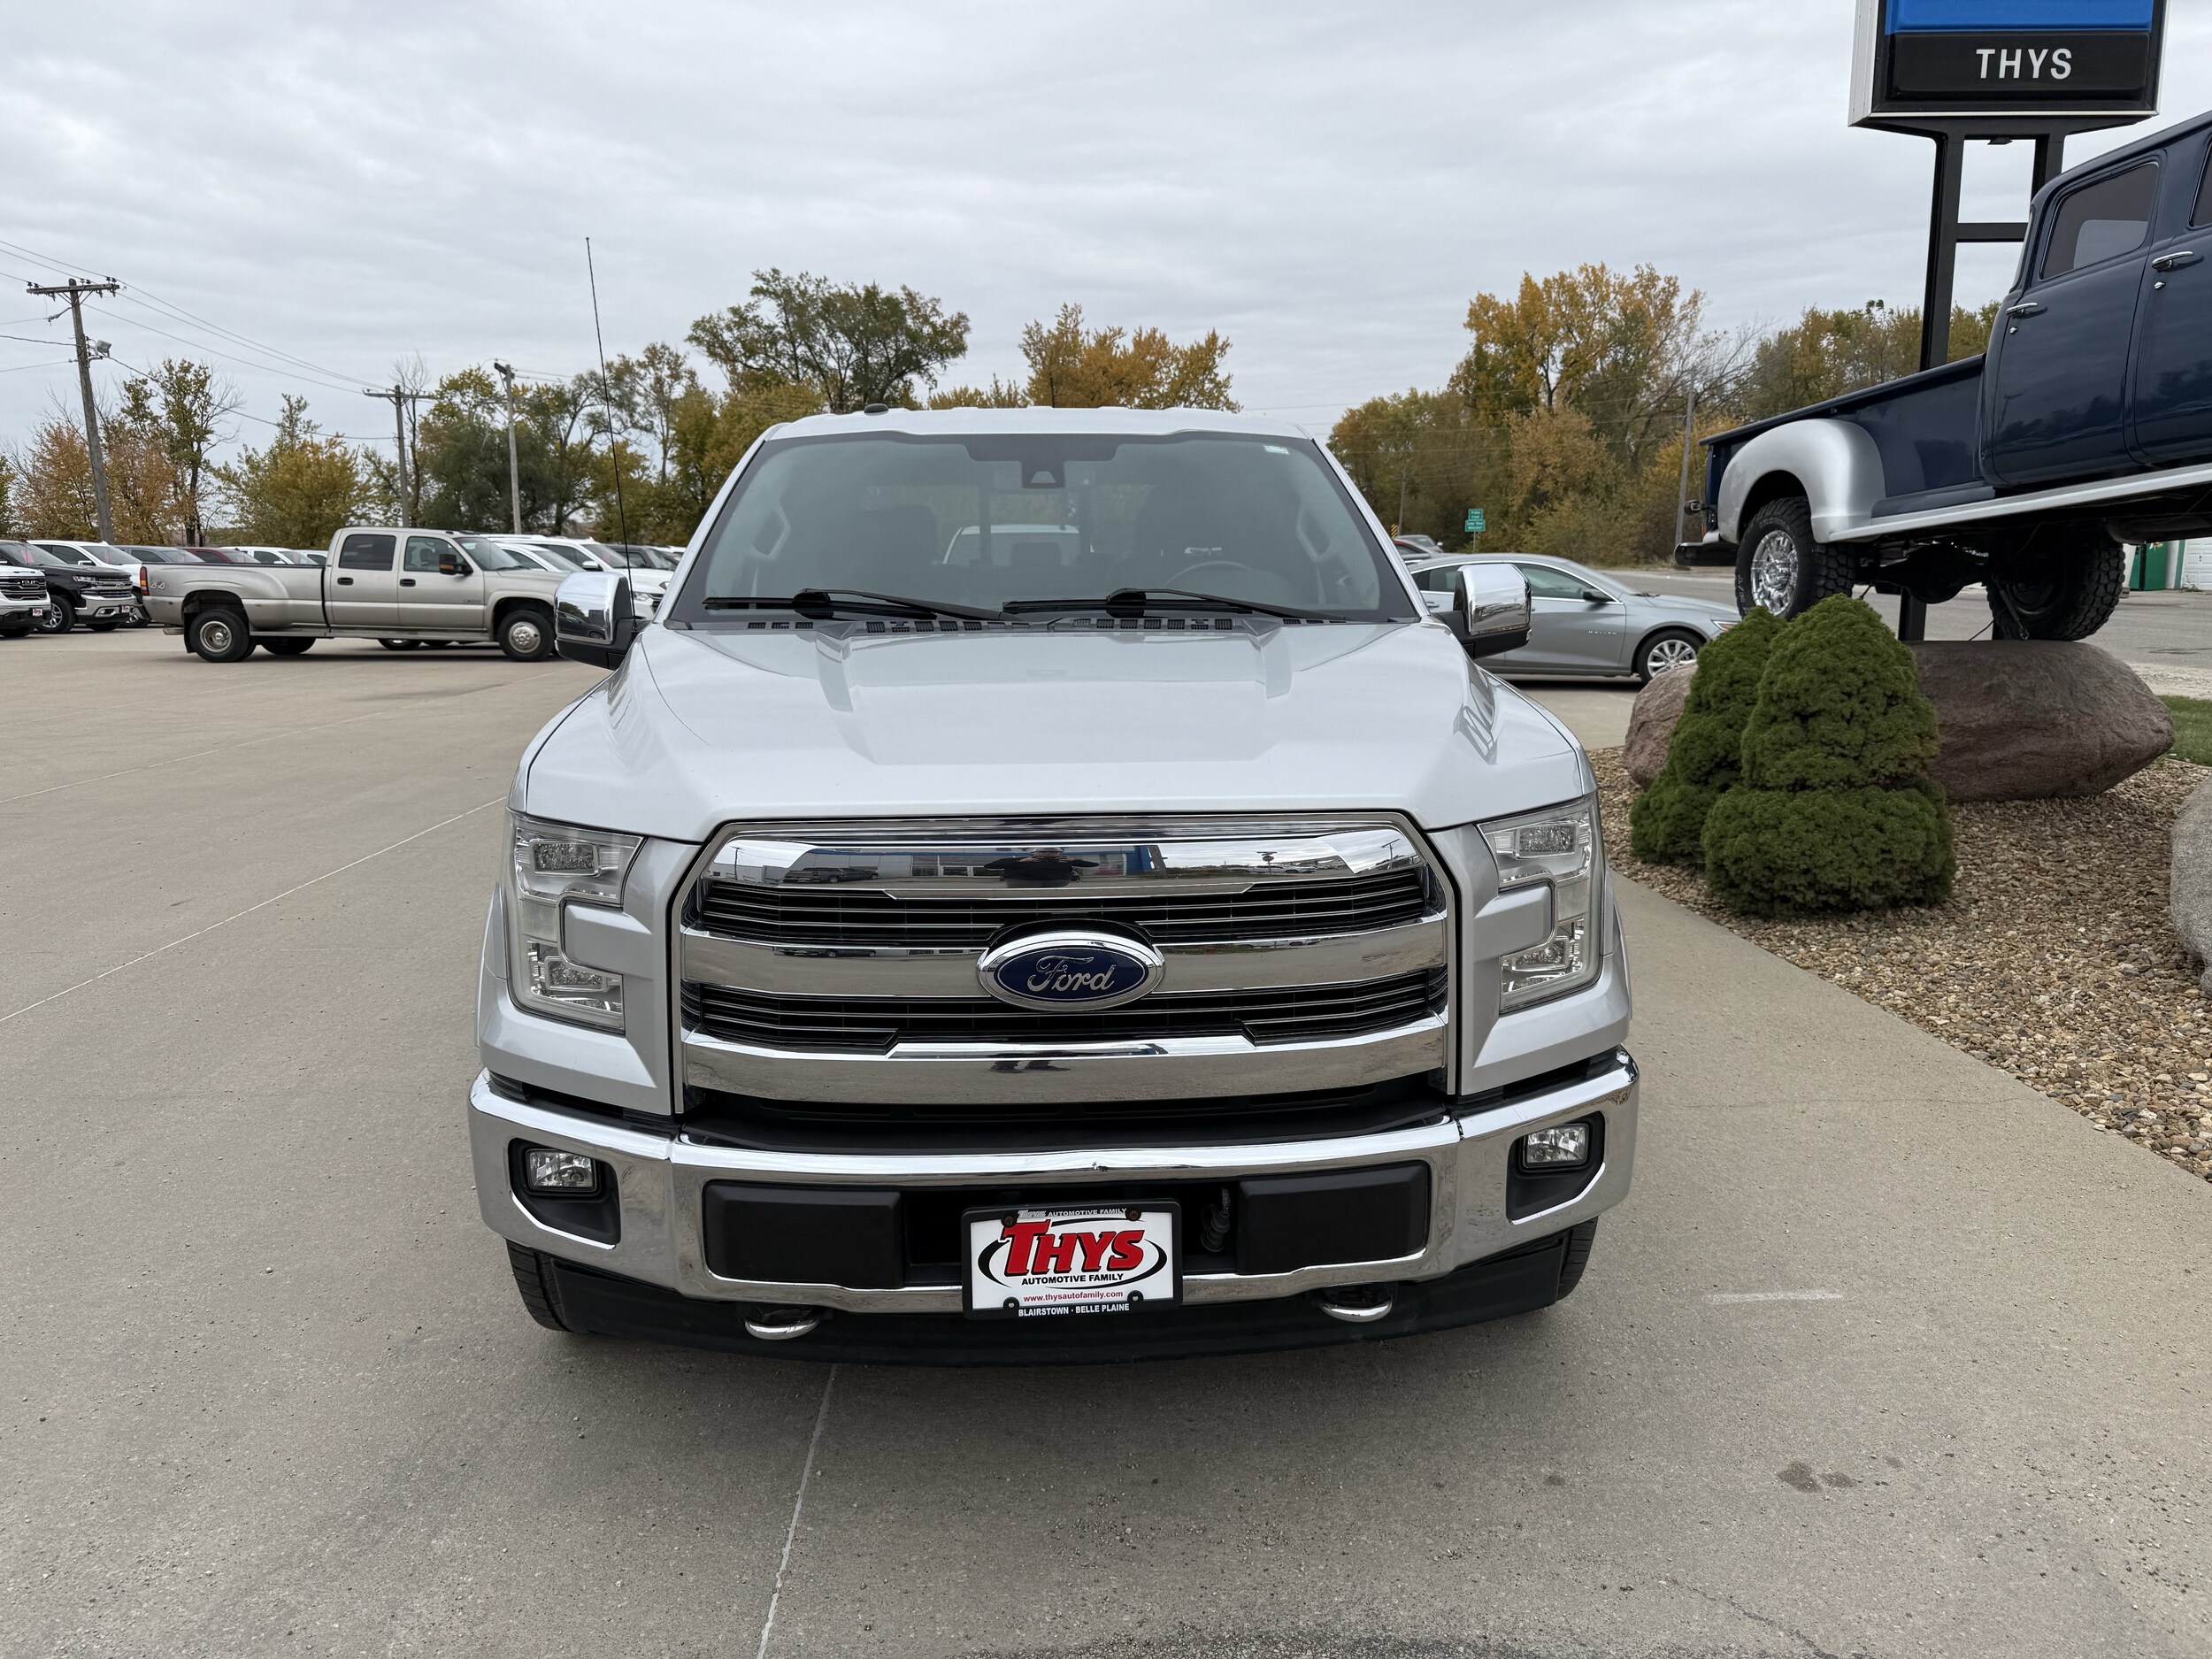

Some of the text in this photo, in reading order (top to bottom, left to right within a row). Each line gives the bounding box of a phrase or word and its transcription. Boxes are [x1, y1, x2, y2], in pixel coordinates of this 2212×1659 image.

[1976, 48, 2073, 80] THYS
[1027, 956, 1117, 992] Ford
[1048, 1209, 1098, 1217] AUTOMOTIVE
[1000, 1219, 1145, 1277] THYS
[1021, 1272, 1124, 1286] AUTOMOTIVE FAMILY
[1023, 1290, 1124, 1302] www.thysautofamily.com
[1018, 1303, 1130, 1317] BLAIRSTOWN BELLE PLAINE
